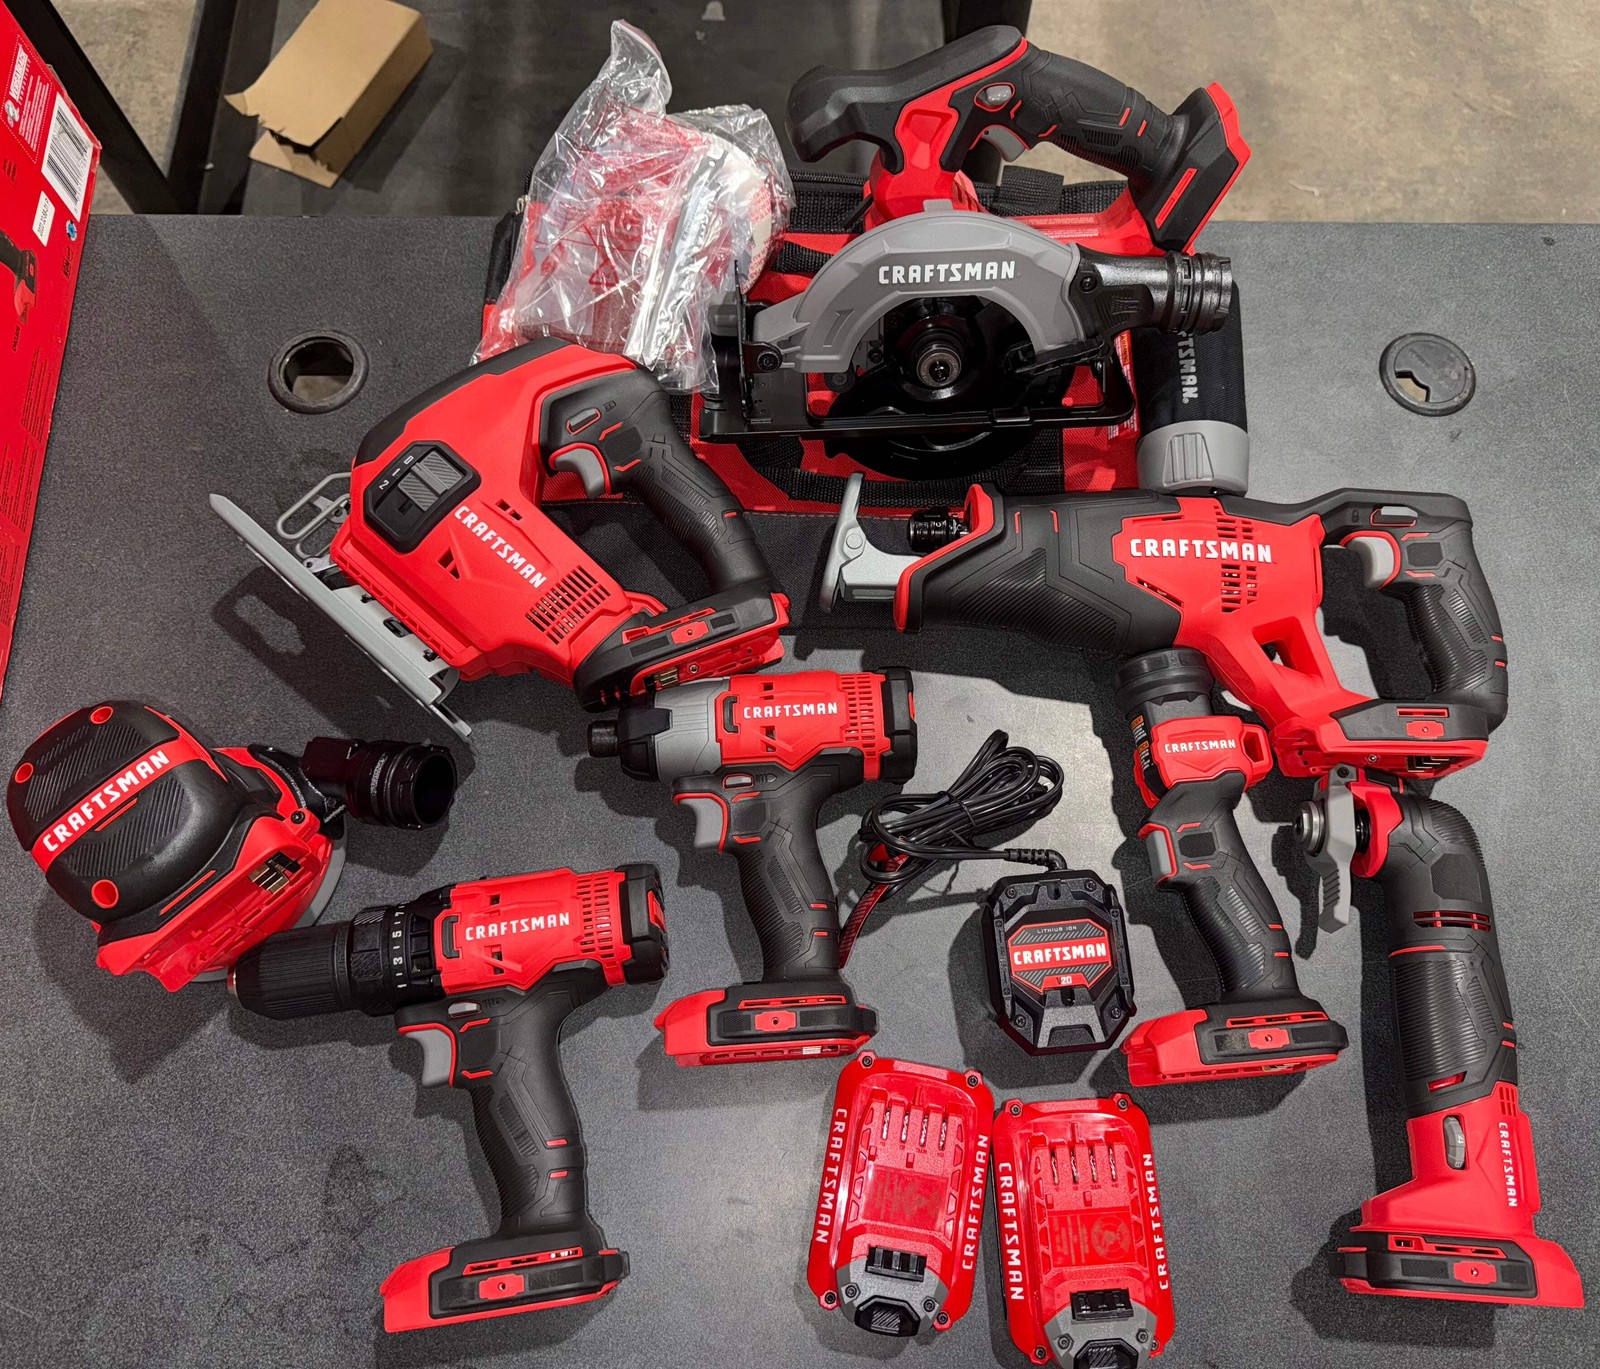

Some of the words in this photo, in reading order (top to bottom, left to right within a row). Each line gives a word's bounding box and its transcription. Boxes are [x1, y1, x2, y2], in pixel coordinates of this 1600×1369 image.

[879, 260, 1016, 285] CRAFTSMAN
[378, 479, 390, 490] 2
[454, 505, 547, 590] CRAFTSMAN
[1130, 537, 1273, 564] CRAFTSMAN
[743, 701, 838, 720] CRAFTSMAN
[1164, 738, 1236, 754] CRAFTSMAN
[43, 750, 170, 852] CRAFTSMAN
[392, 930, 402, 939] 5
[465, 911, 570, 941] CRAFTSMAN
[393, 956, 403, 966] 3
[1013, 942, 1107, 966] CRAFTSMAN
[814, 1108, 848, 1244] CRAFTSMAN
[1498, 1122, 1518, 1207] CRAFTSMAN
[958, 1134, 989, 1270] CRAFTSMAN
[998, 1162, 1025, 1301] CRAFTSMAN
[1143, 1153, 1169, 1290] CRAFTSMAN
